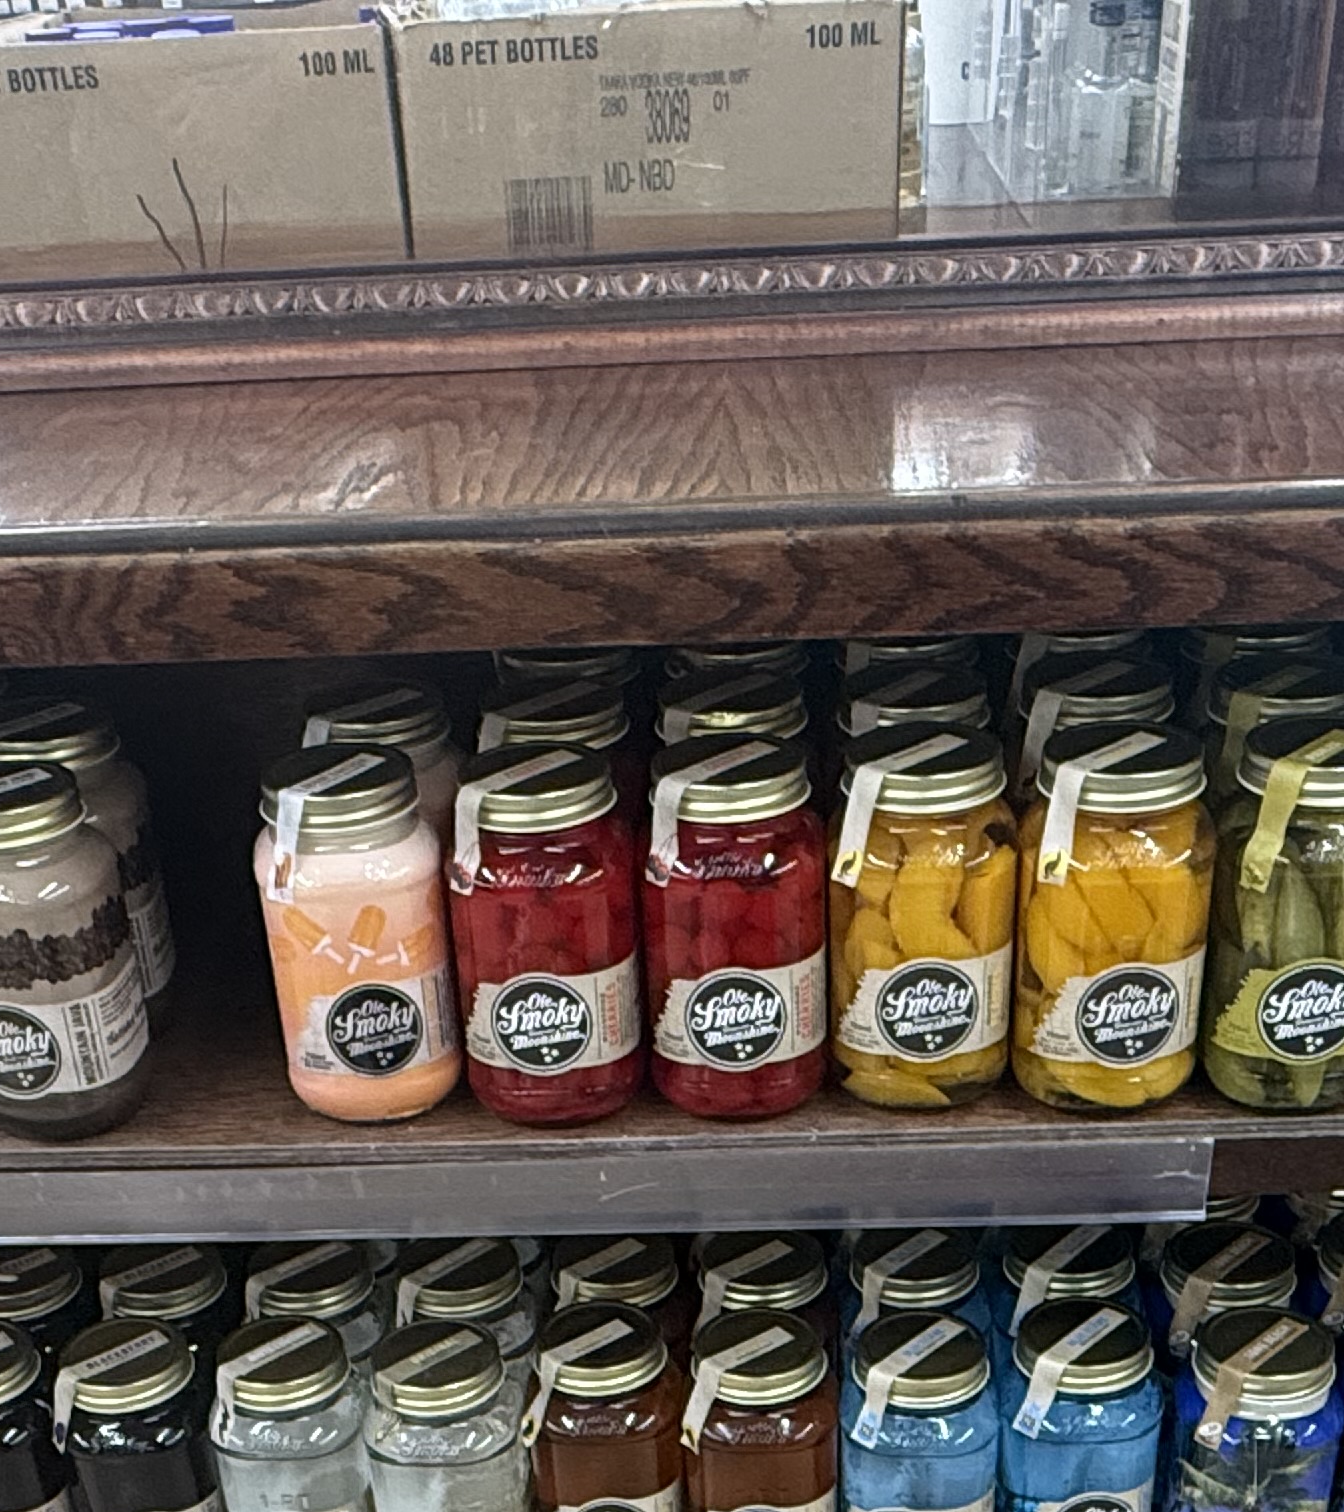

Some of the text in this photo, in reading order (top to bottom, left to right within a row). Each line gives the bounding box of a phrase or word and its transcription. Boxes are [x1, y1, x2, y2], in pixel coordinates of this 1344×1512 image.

[806, 22, 881, 49] 100 ML
[298, 48, 375, 76] 100 ML
[430, 36, 598, 66] 48 PET BOTTLES
[8, 65, 98, 92] BOTTLES
[713, 91, 730, 111] 01
[721, 989, 754, 1008] Ole
[918, 977, 948, 998] Ole
[1118, 983, 1151, 1001] Ole
[1303, 980, 1336, 1001] Ole
[360, 999, 392, 1017] Ole
[529, 991, 563, 1012] Ole
[690, 995, 781, 1032] Smoky
[883, 987, 973, 1023] Smoky
[1086, 988, 1173, 1024] Smoky
[332, 1002, 416, 1042] Smoky
[498, 1001, 586, 1035] Smoky
